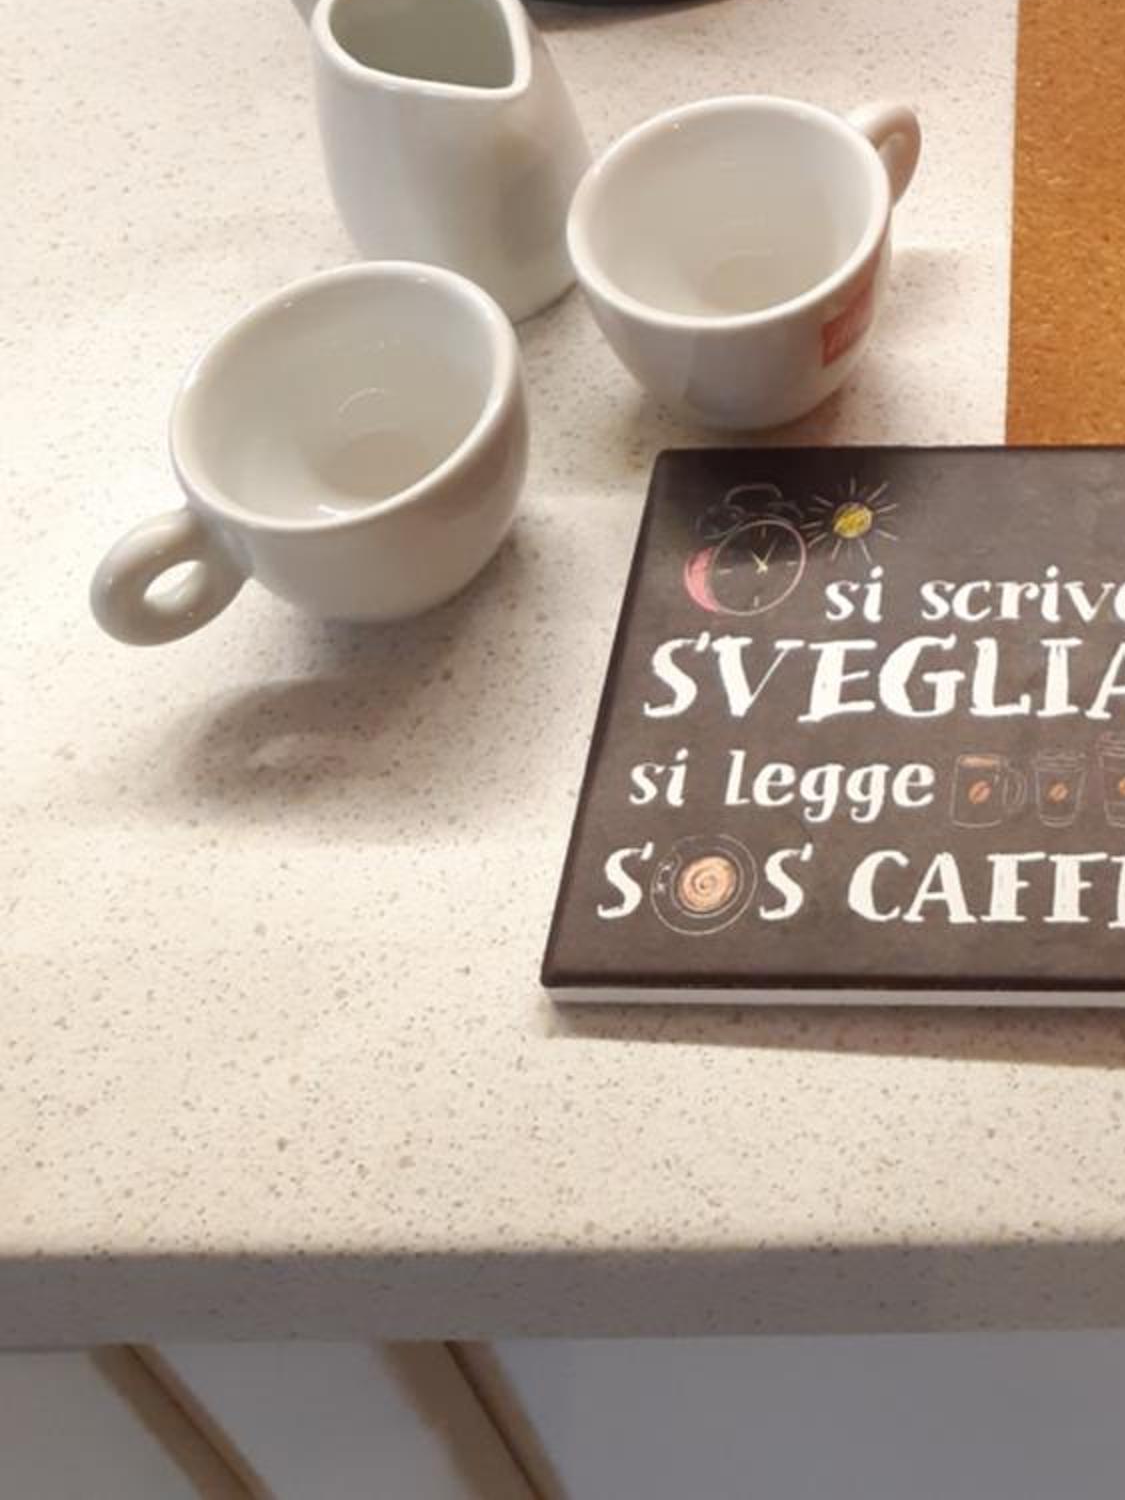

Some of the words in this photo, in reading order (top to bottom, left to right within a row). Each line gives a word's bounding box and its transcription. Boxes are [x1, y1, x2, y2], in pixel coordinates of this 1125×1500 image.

[824, 565, 883, 623] si
[628, 748, 690, 807] si
[724, 750, 936, 823] legge
